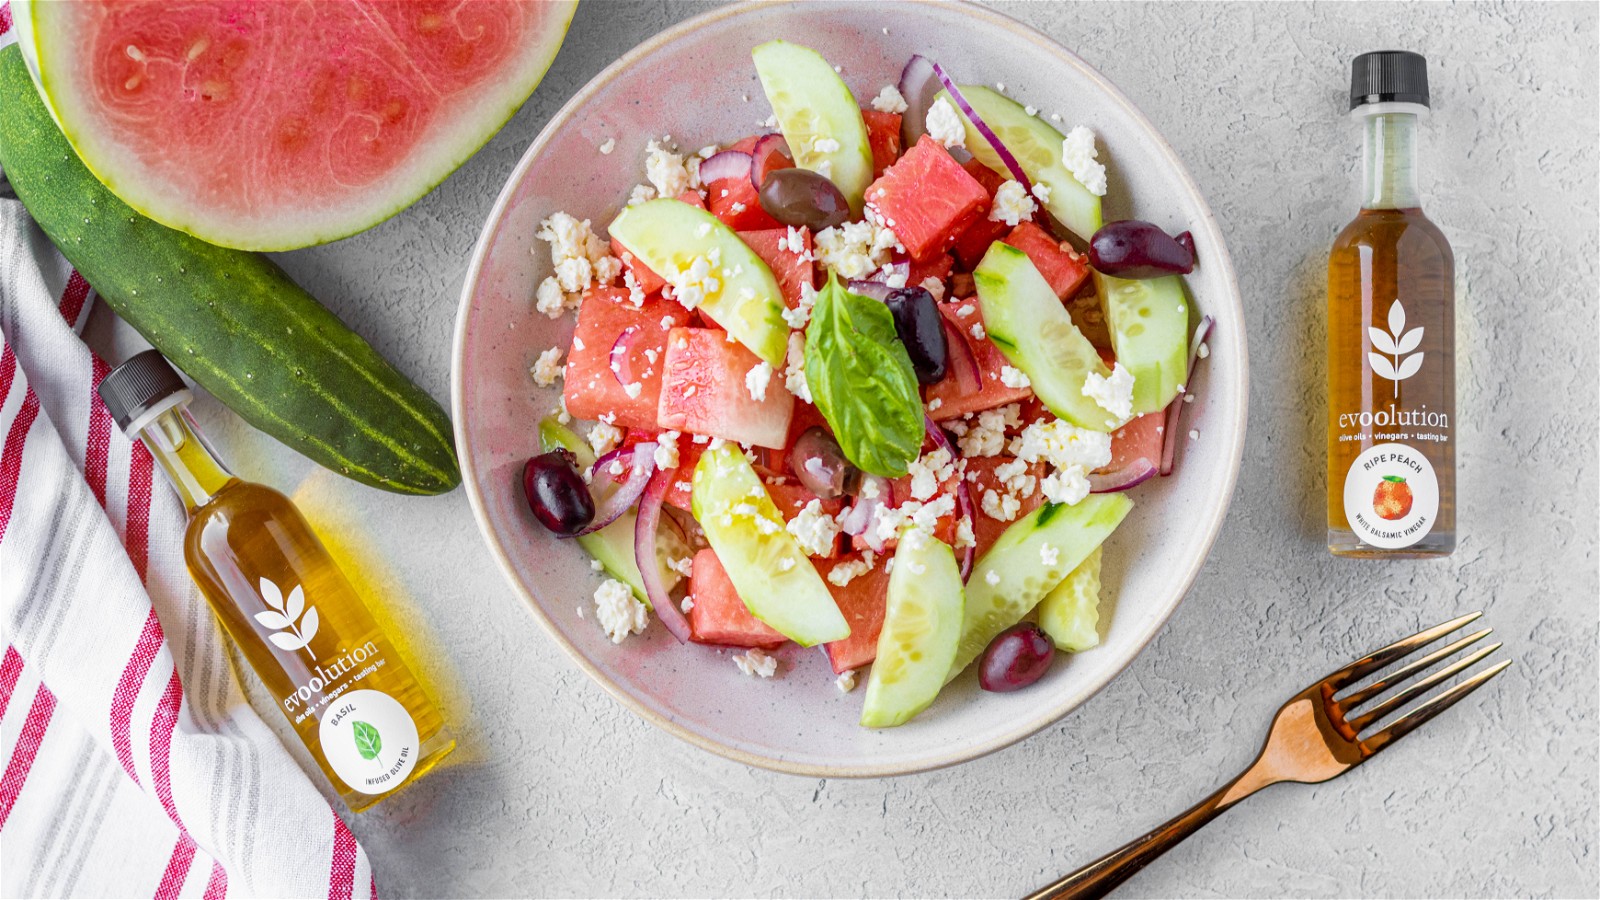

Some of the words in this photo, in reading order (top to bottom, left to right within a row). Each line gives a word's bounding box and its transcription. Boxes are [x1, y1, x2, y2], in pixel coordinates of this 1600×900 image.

[1339, 403, 1449, 428] evoolution
[1353, 432, 1366, 441] oils
[1374, 432, 1409, 441] vinegars
[1416, 432, 1439, 442] tasting
[1363, 454, 1387, 471] RIPE
[1390, 453, 1423, 474] PEACH
[1355, 512, 1371, 531] WHITE
[1370, 527, 1403, 539] BALSAMIC
[1403, 516, 1427, 537] VINEGAR
[284, 641, 379, 712] evoolution
[319, 682, 349, 705] vinegars
[353, 664, 378, 681] tasting
[330, 703, 357, 726] BASIL
[365, 773, 391, 785] INFUSED
[390, 758, 406, 775] OLIVE
[400, 746, 410, 758] OIL
